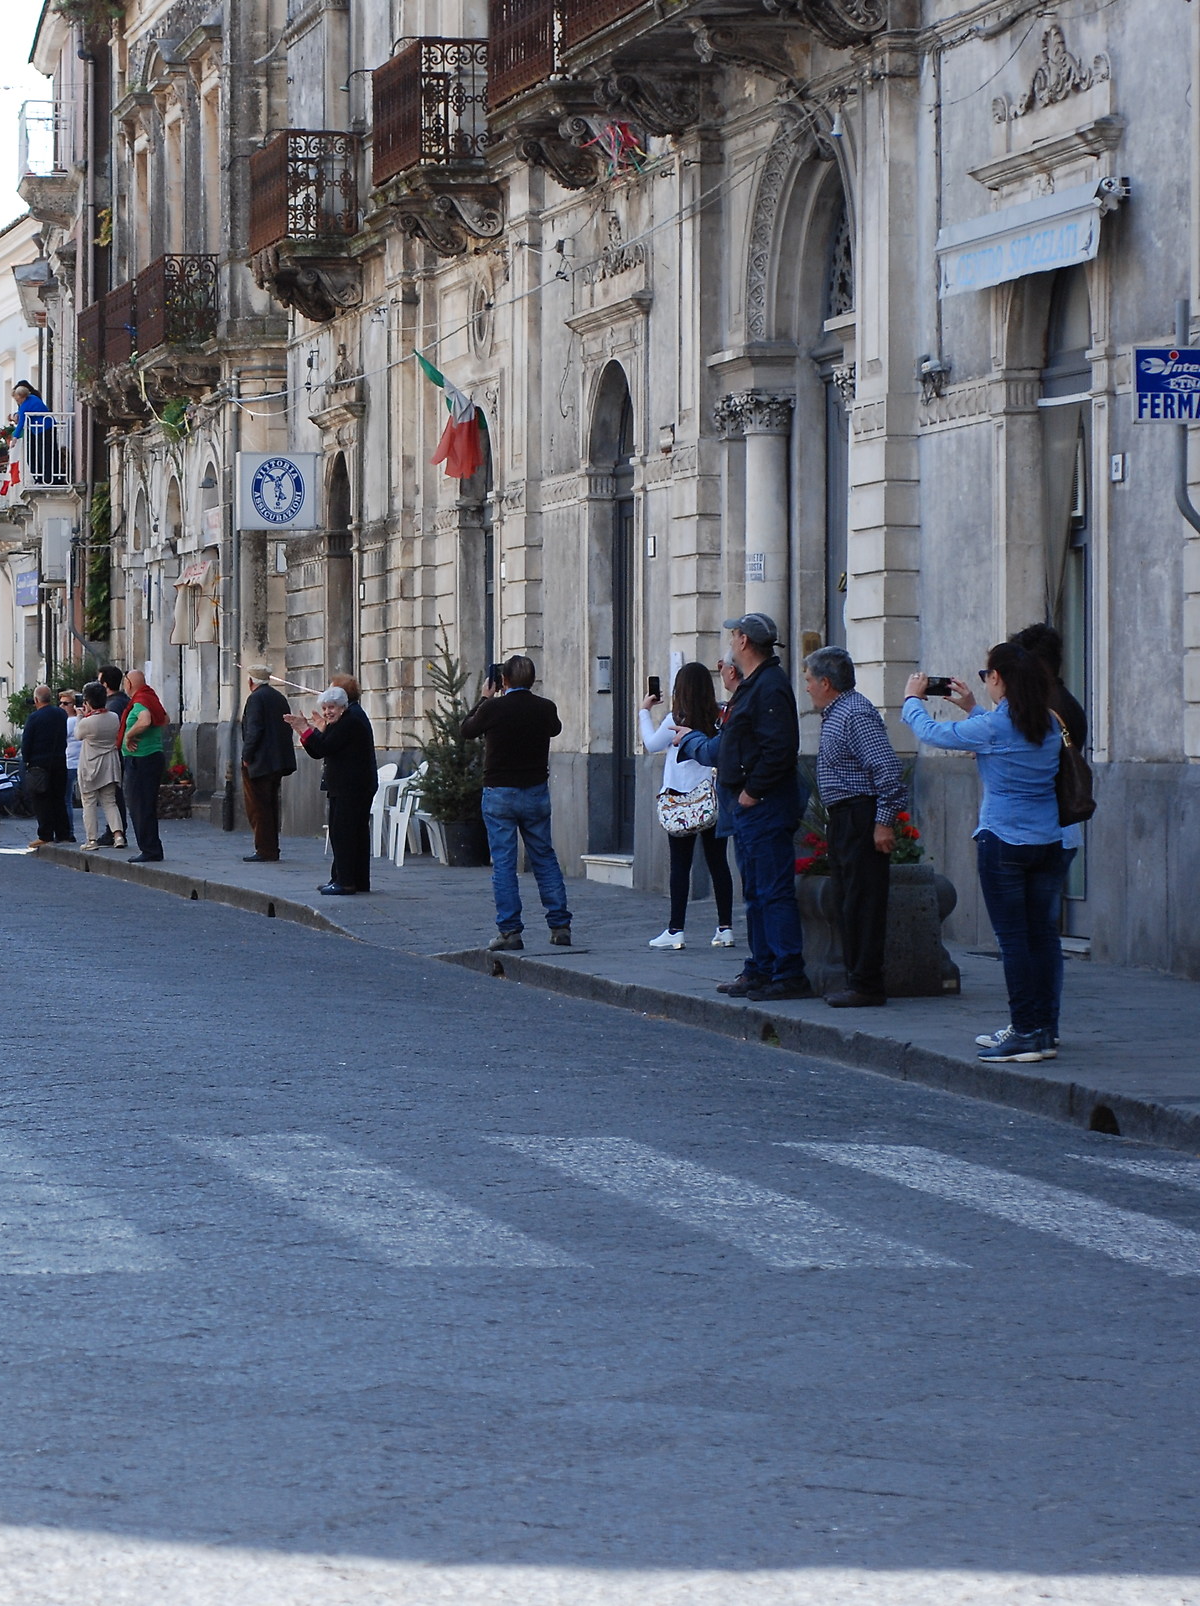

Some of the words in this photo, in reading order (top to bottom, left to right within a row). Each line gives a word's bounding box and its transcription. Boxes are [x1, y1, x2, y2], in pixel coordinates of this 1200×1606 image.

[957, 244, 1005, 285] CENTRO
[1008, 223, 1079, 272] SURGELATI
[256, 460, 298, 479] VITTORIA
[254, 491, 302, 521] ASSICURAZIONI
